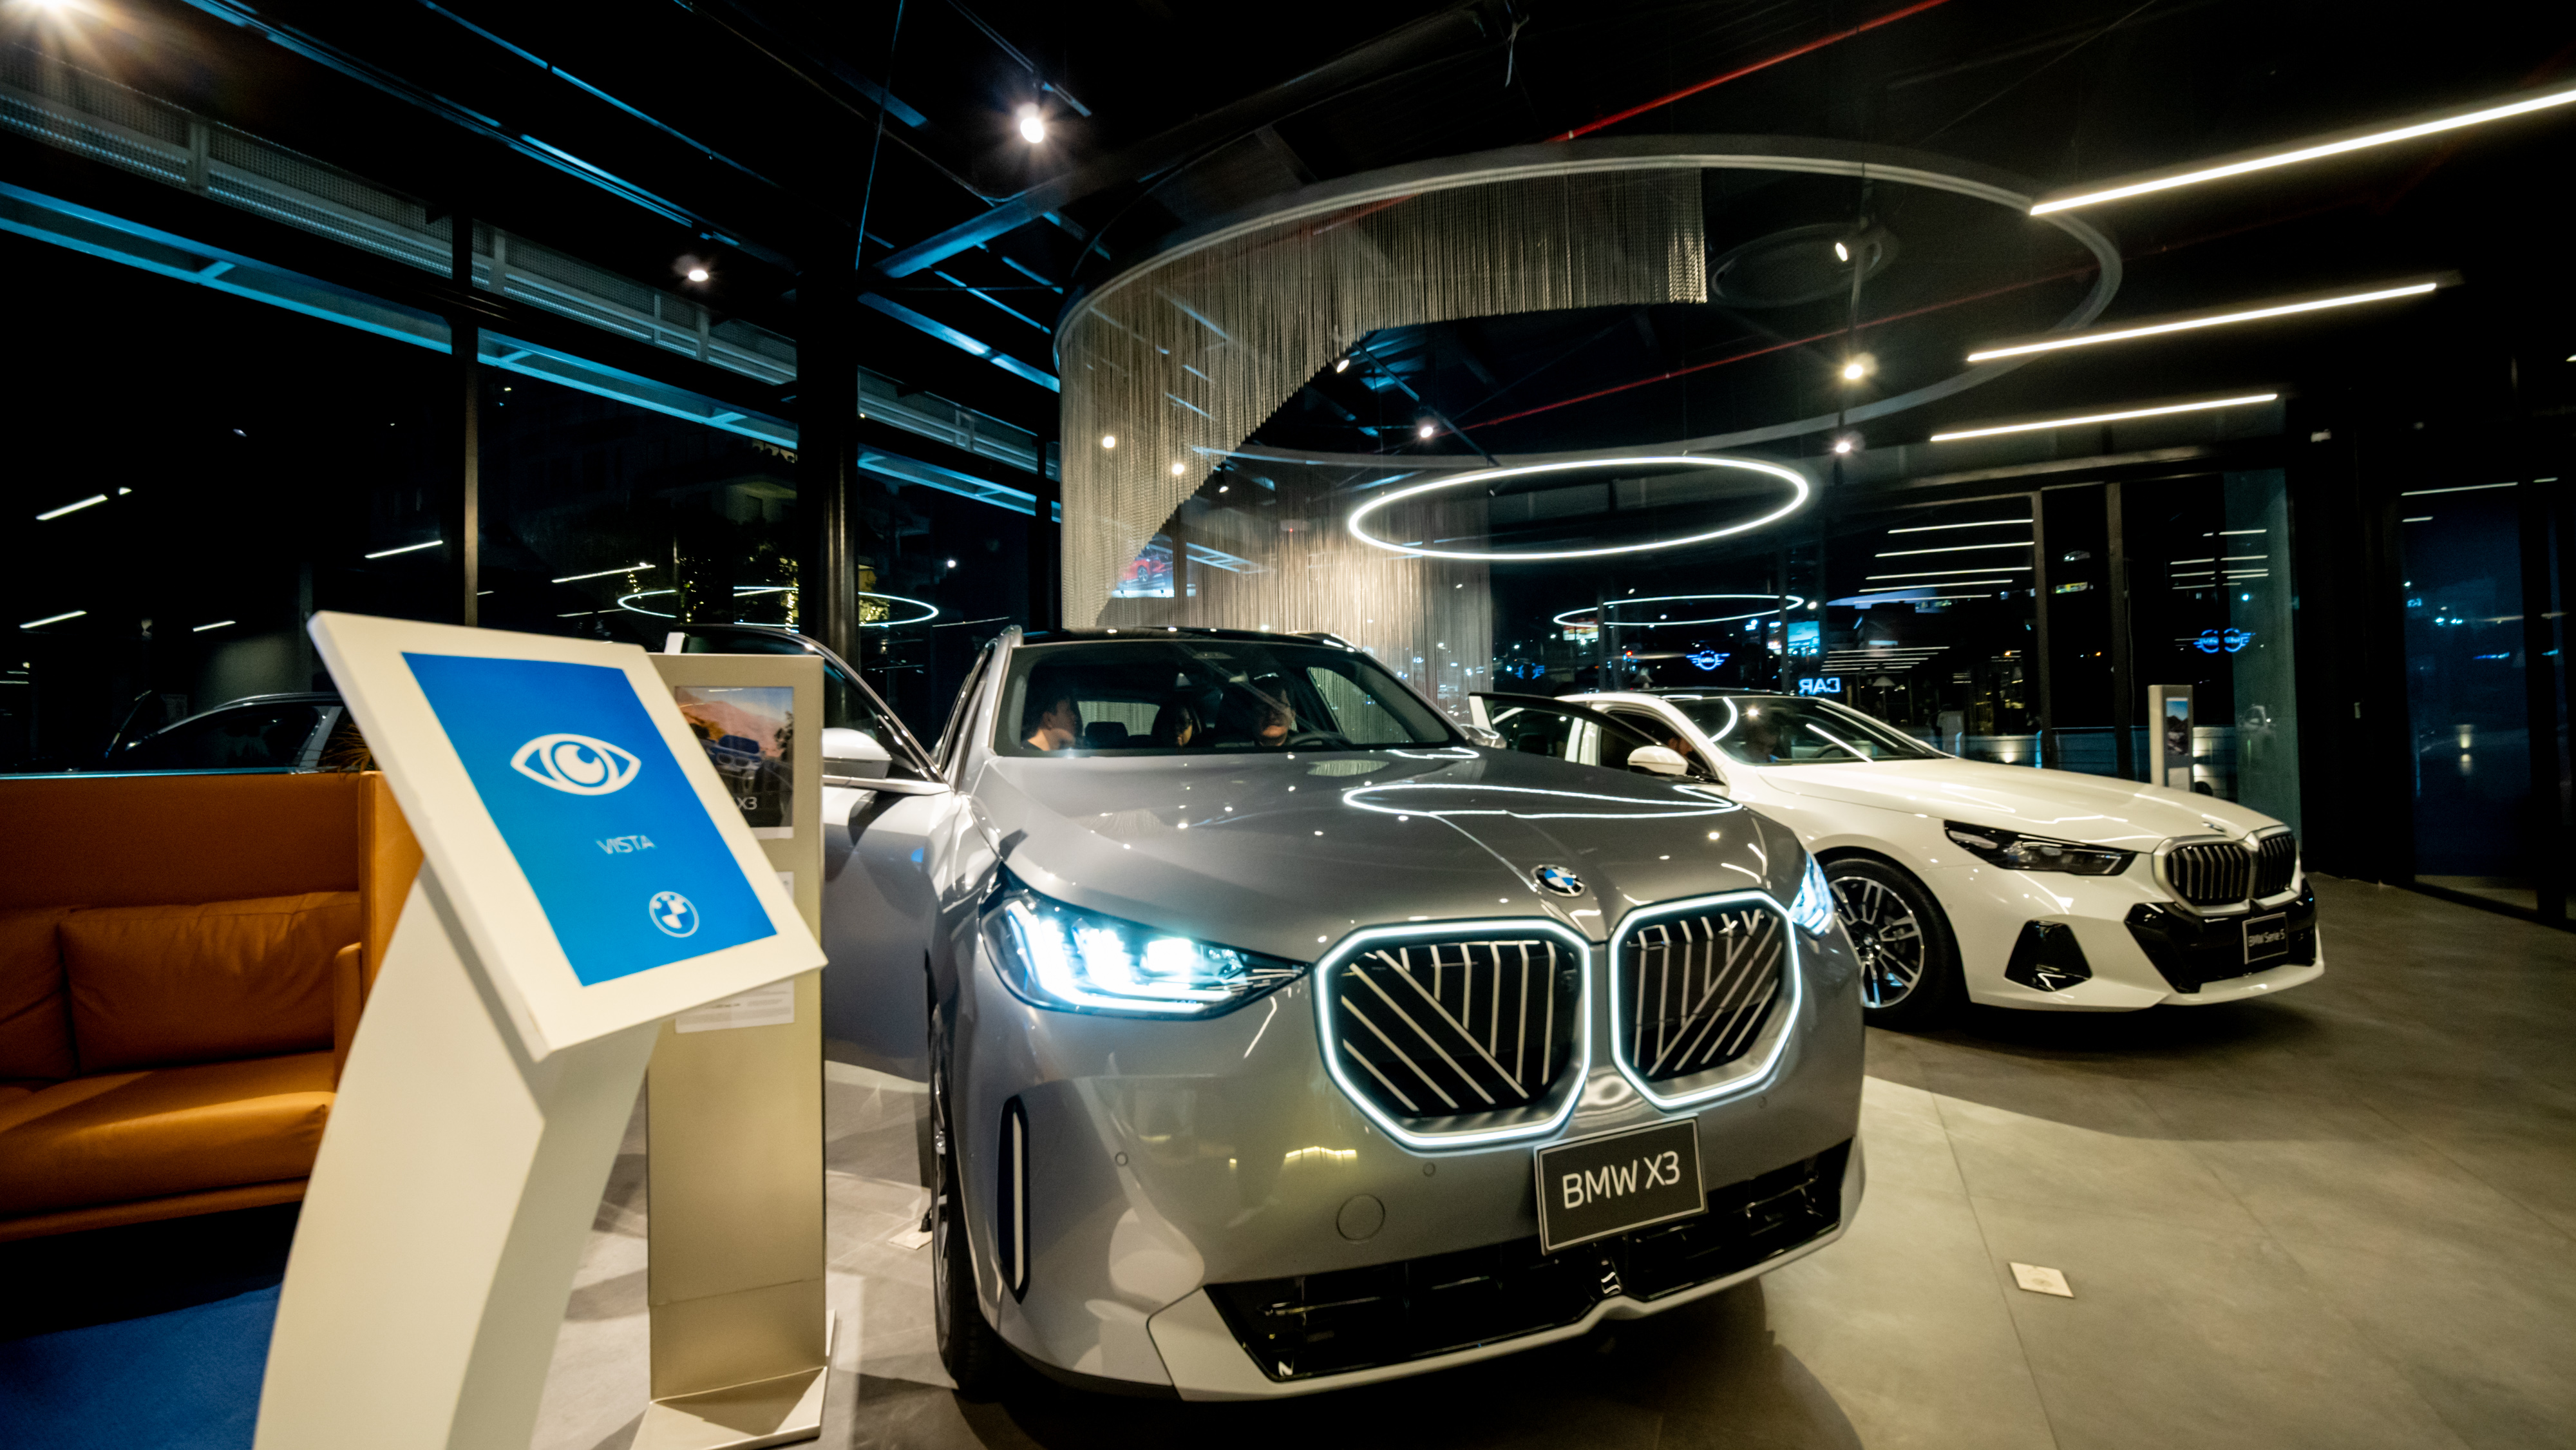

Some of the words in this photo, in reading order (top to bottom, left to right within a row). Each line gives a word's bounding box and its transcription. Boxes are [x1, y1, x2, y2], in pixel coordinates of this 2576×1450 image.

[735, 796, 758, 810] X3
[596, 835, 658, 854] VISTA
[1562, 1159, 1638, 1209] BMW
[1643, 1150, 1681, 1190] X3
